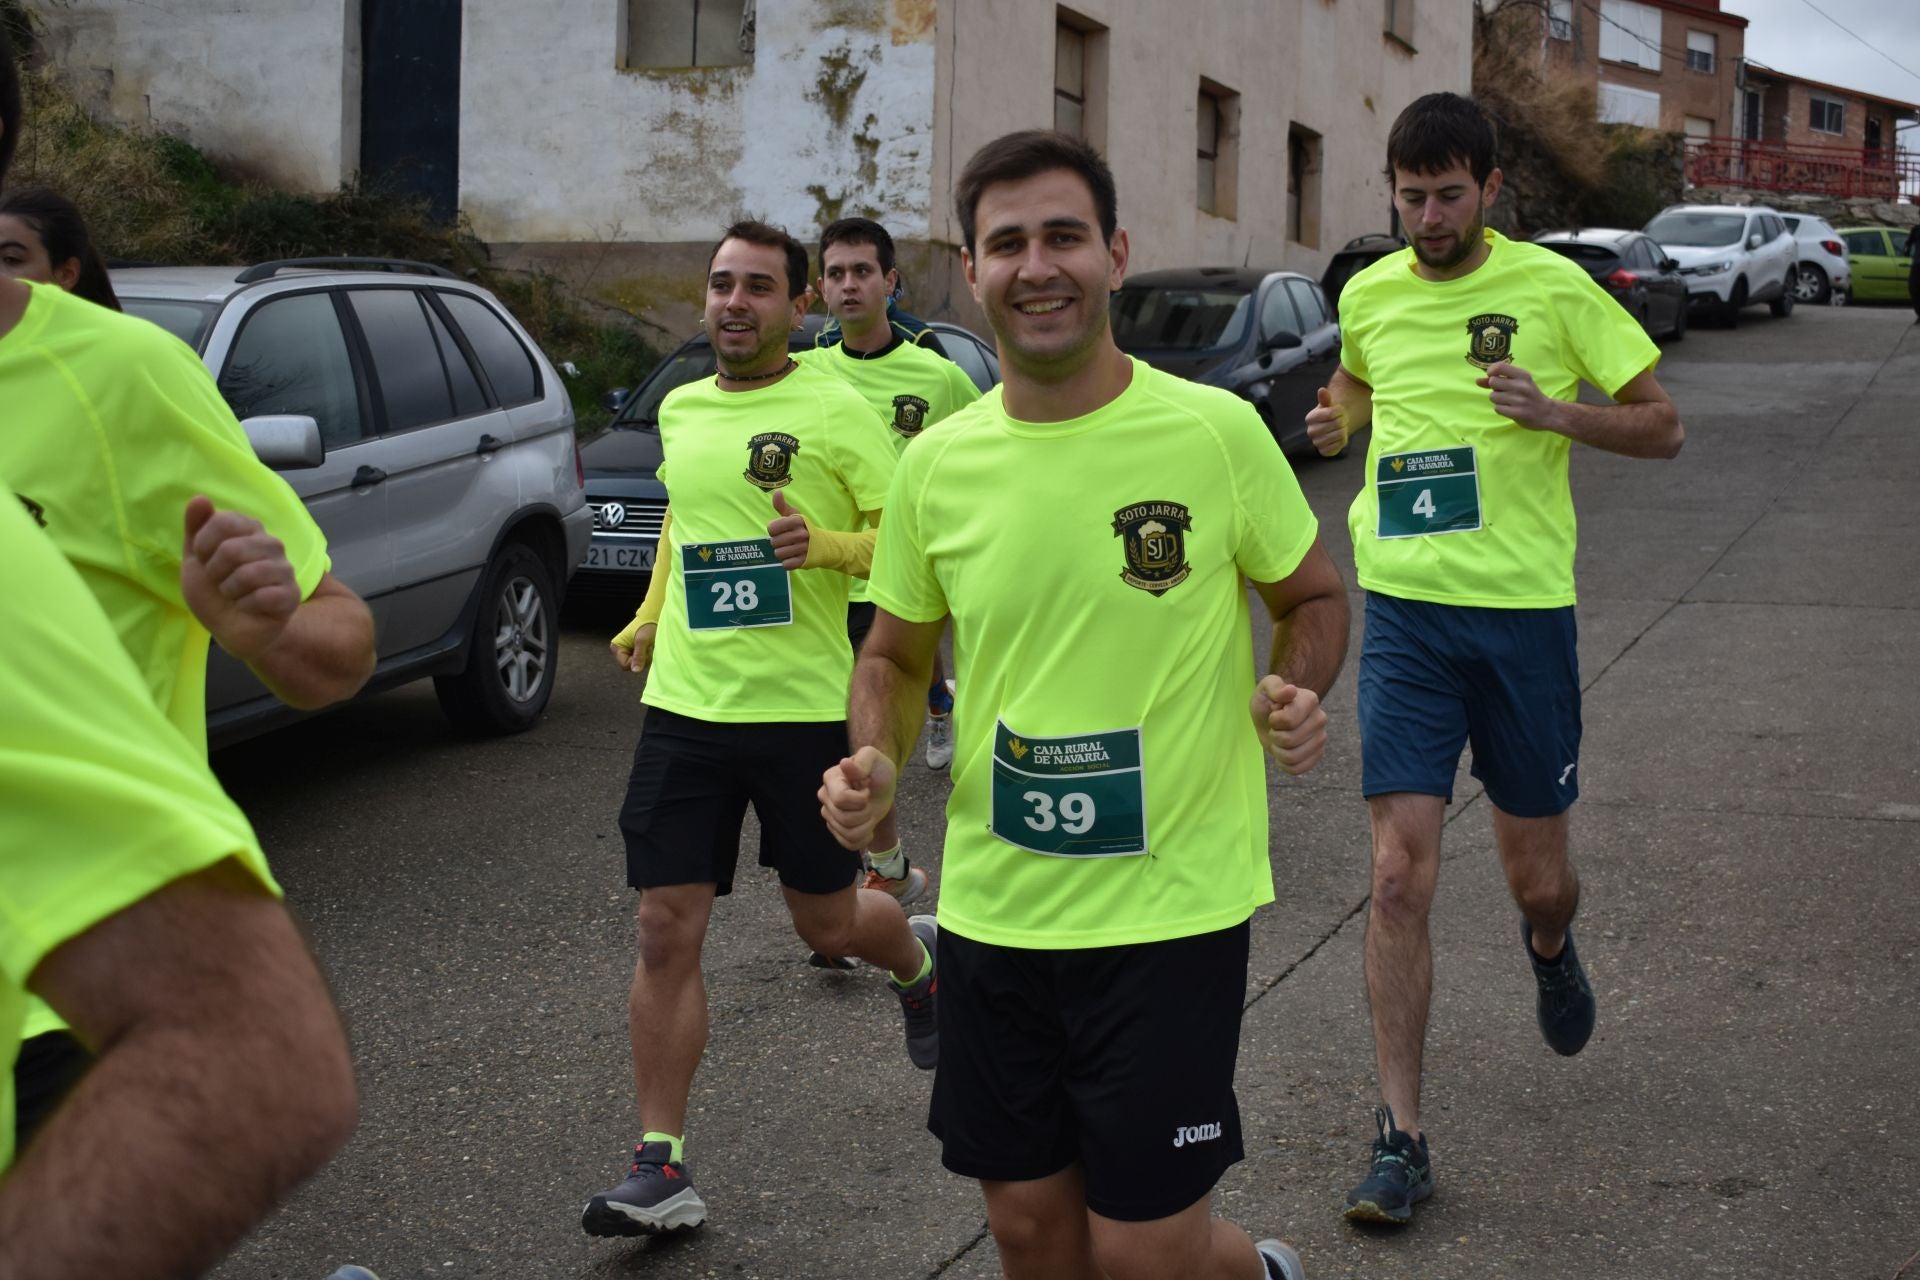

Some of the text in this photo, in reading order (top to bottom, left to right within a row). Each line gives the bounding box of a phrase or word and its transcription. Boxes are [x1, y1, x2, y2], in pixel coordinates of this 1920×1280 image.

[1485, 336, 1497, 350] SJ
[753, 434, 797, 447] SOTO JARRA
[764, 454, 776, 468] SJ
[1406, 454, 1451, 465] CAJA RURAL
[1407, 464, 1417, 472] DE
[1418, 460, 1455, 471] NAVARRA
[1412, 488, 1437, 519] 4
[1119, 504, 1185, 524] SOTO JARRA
[715, 544, 761, 555] CAJA RURAL
[716, 551, 765, 562] DE NAVARRA
[1147, 538, 1163, 560] SJ
[582, 548, 651, 567] 21 CZK
[710, 579, 759, 613] 28
[1033, 741, 1105, 756] CAJA RURAL
[1033, 750, 1111, 765] DE NAVARRA
[1022, 790, 1097, 835] 39
